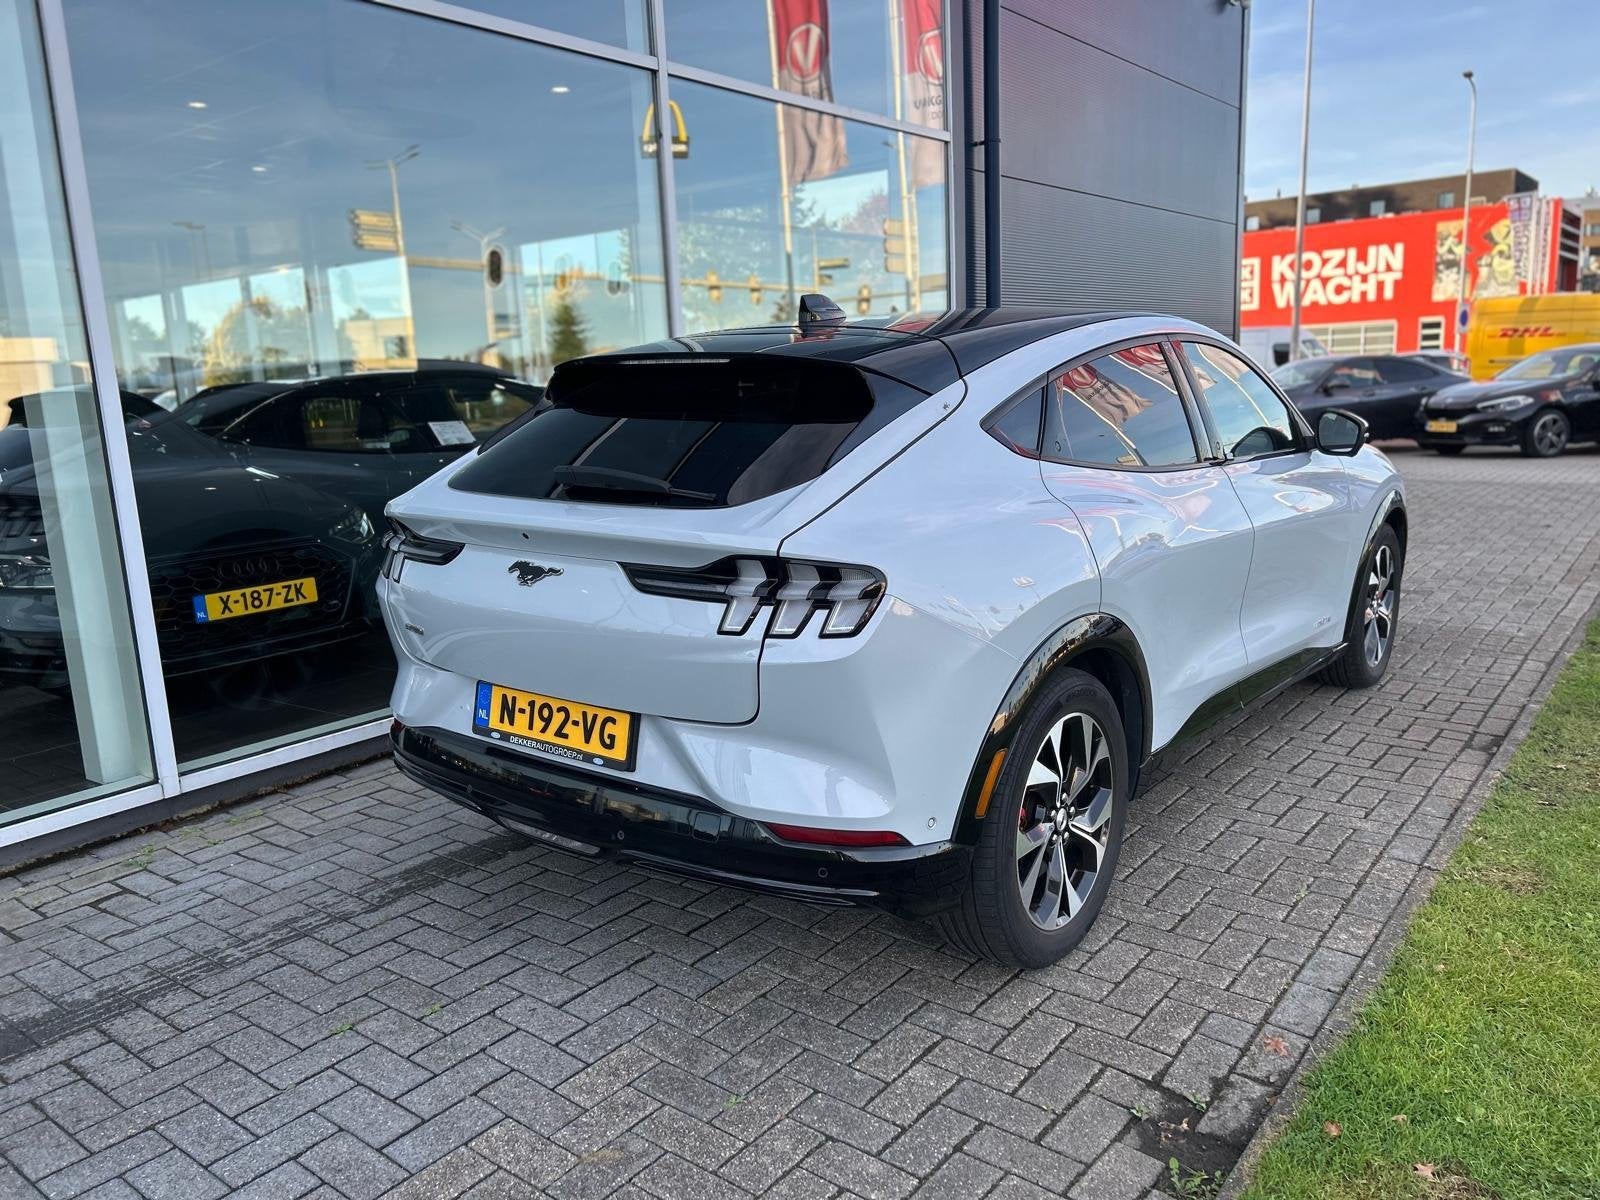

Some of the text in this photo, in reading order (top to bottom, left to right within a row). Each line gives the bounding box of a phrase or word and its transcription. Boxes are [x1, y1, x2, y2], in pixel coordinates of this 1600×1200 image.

[1271, 242, 1404, 281] KOZIJN
[1271, 271, 1403, 309] WACHT
[1499, 326, 1553, 338] DHL
[218, 582, 307, 615] X-187-ZK
[478, 708, 488, 720] NL
[499, 693, 617, 750] N-192-VG
[509, 735, 583, 761] DEKKERAUTOGROEP.nl
